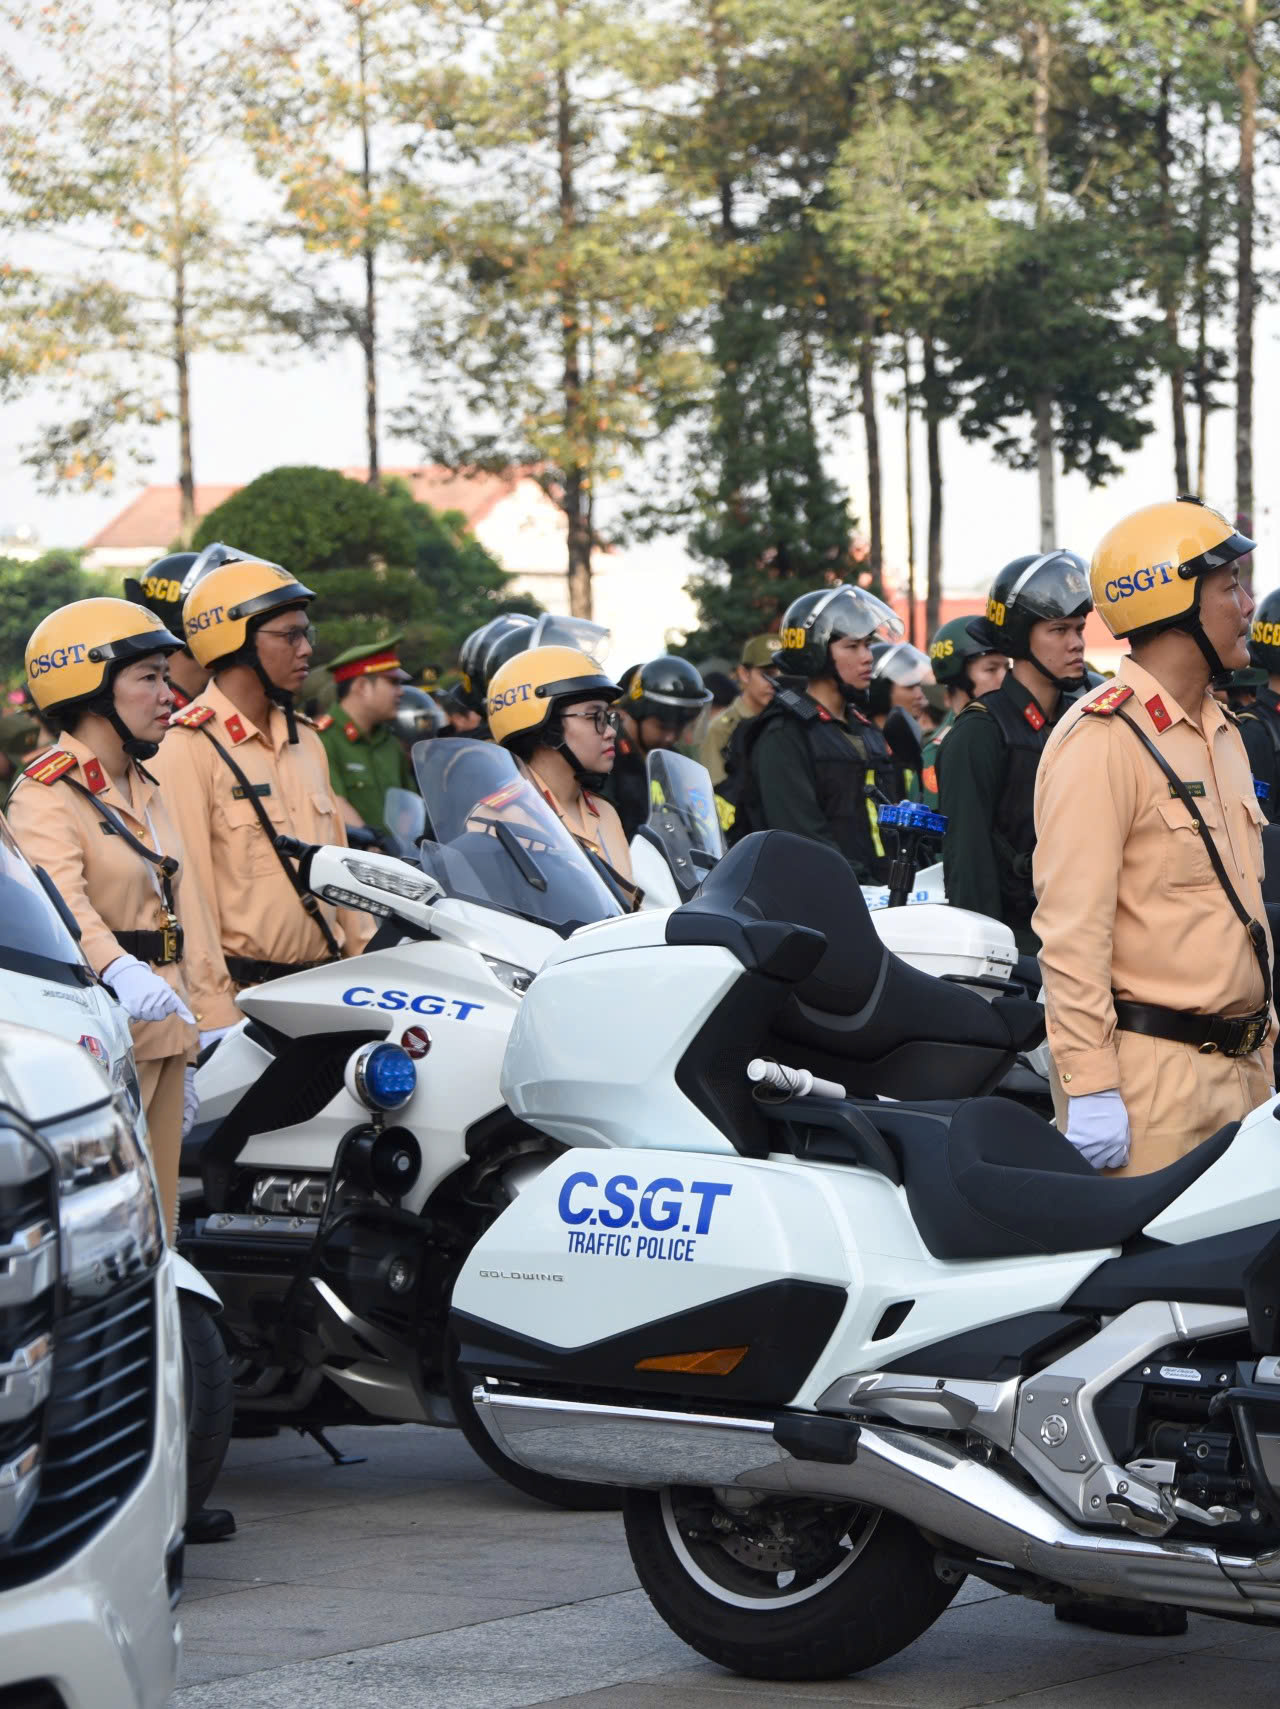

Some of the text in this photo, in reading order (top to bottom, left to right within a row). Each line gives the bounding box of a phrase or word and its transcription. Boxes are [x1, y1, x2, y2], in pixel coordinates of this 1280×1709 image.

[1105, 561, 1173, 603] CSGT
[185, 606, 224, 636] SGT
[29, 643, 85, 679] CSGT
[342, 986, 485, 1021] C.S.G.T
[558, 1171, 733, 1235] C.S.G.T
[568, 1231, 696, 1262] TRAFFIC POLICE
[479, 1270, 564, 1282] GOLDWING
